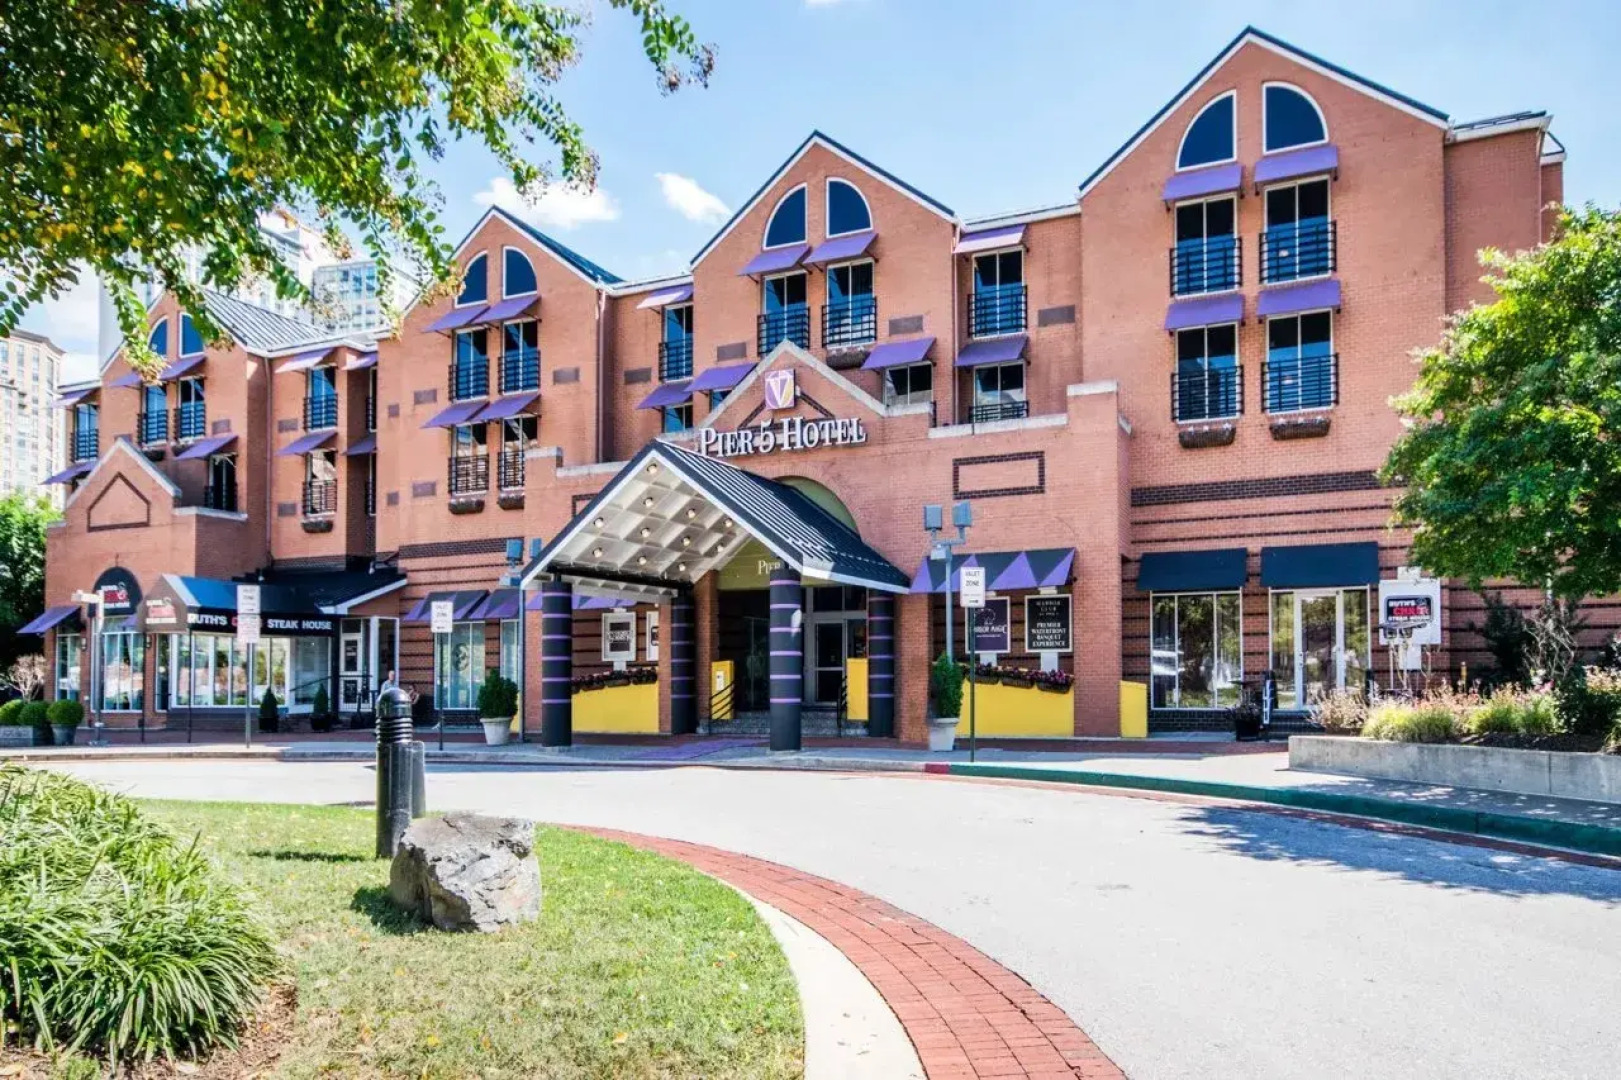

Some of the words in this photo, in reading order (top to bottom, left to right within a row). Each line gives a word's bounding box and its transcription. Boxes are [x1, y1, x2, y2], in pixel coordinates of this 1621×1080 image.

[698, 428, 754, 457] PIER
[759, 418, 774, 453] 5
[780, 416, 867, 450] HOTEL
[187, 614, 227, 625] RUTH'S
[267, 619, 298, 628] STEAK
[302, 620, 332, 629] HOUSE
